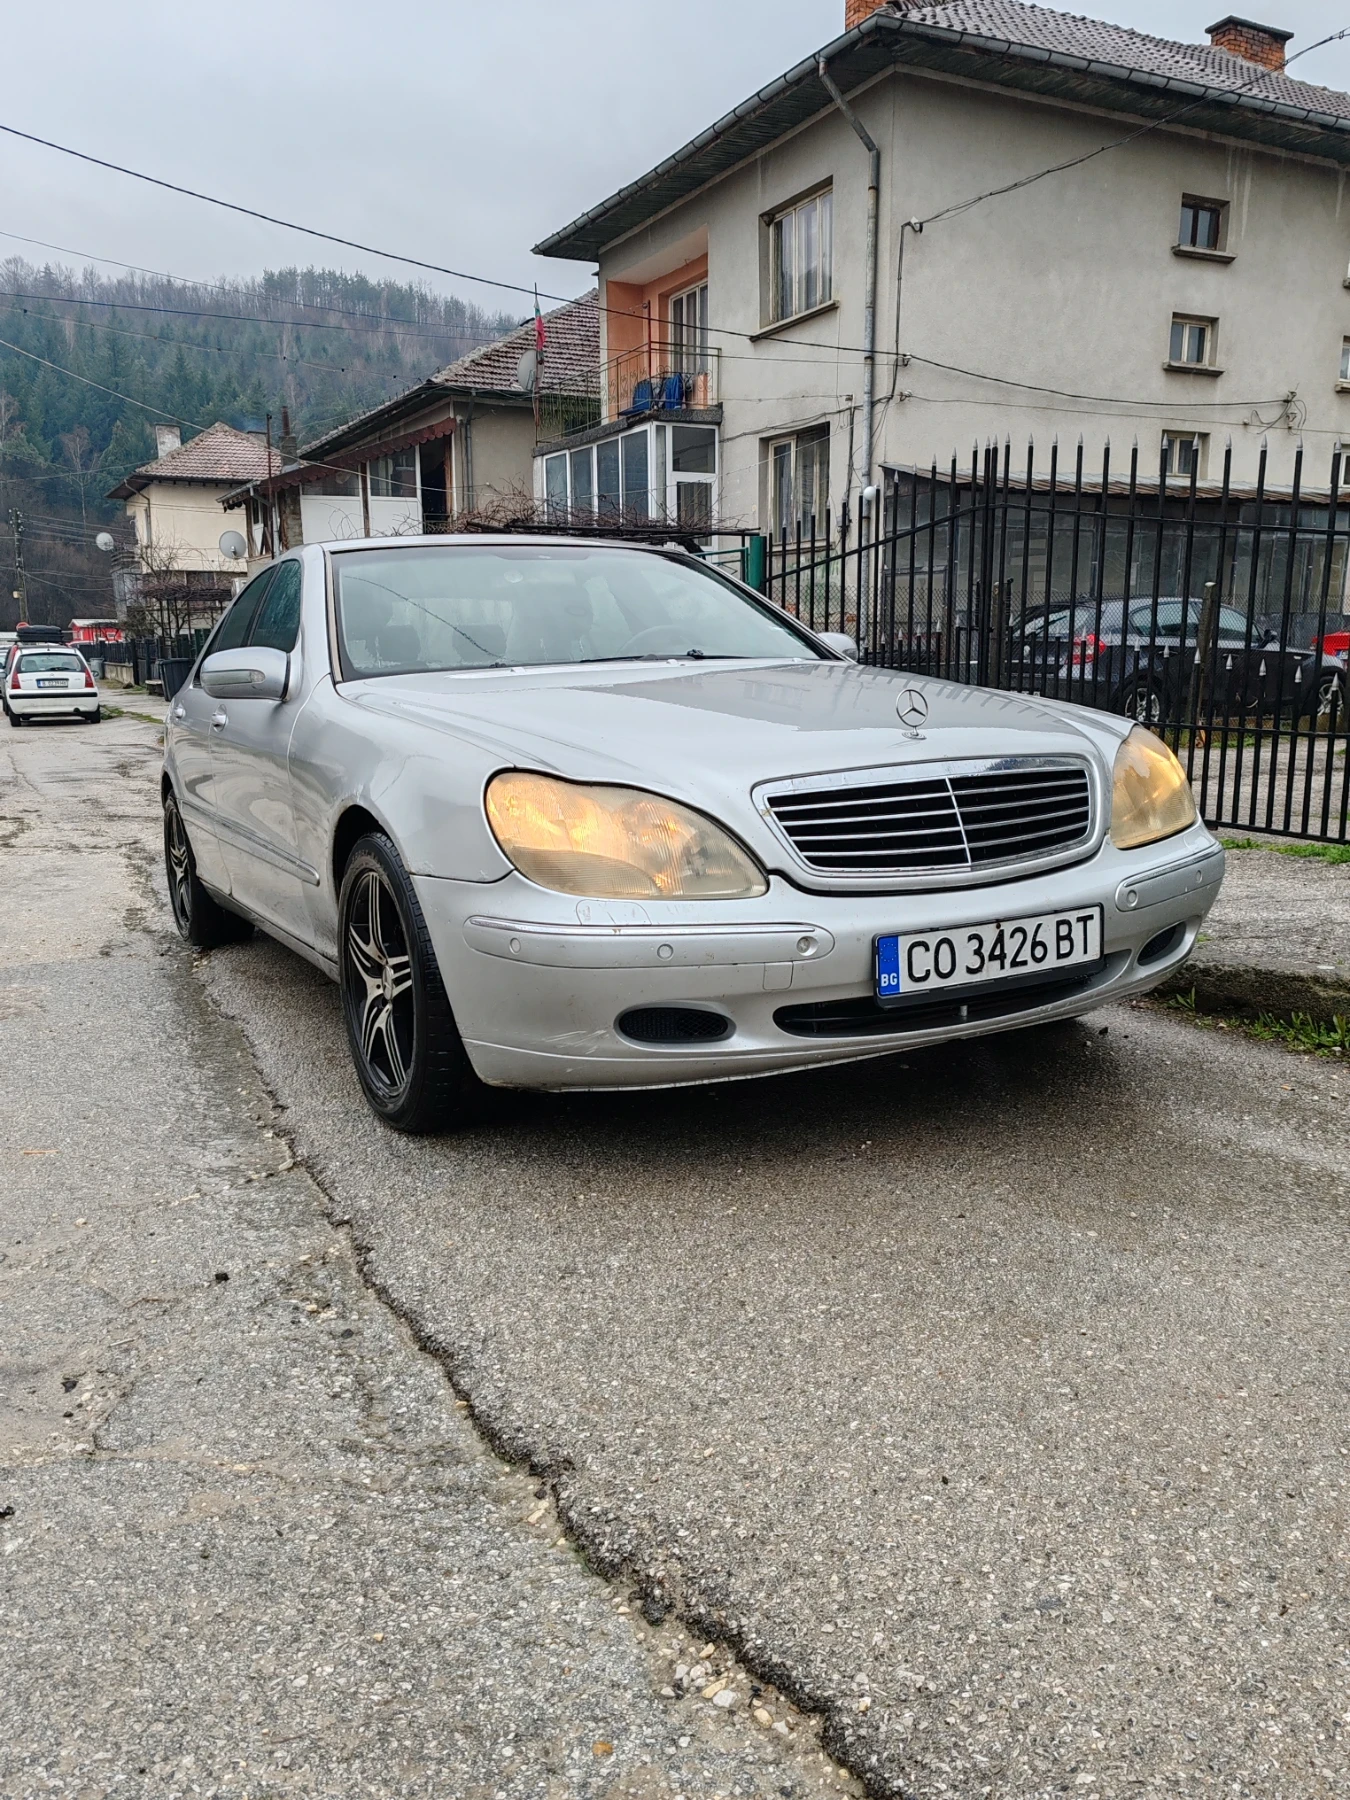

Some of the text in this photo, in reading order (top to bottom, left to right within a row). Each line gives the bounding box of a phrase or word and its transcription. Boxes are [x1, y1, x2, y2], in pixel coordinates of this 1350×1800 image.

[906, 914, 1094, 983] CO 3426 BT
[880, 973, 898, 987] BG
